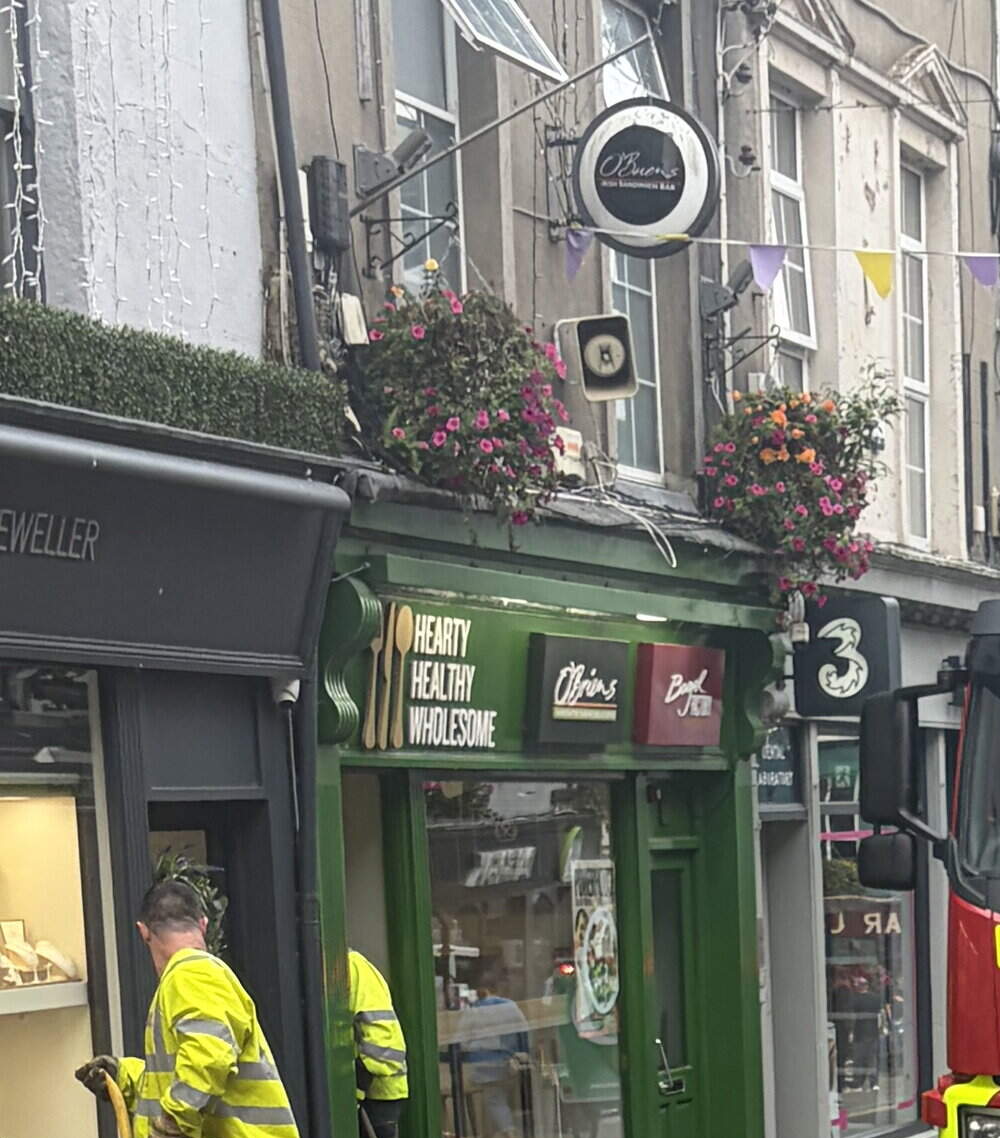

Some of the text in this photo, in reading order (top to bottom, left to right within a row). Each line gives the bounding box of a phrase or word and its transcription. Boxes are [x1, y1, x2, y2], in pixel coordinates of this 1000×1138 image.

[414, 614, 472, 658] HEARTY
[817, 617, 869, 698] 3
[411, 660, 476, 703] HEALTHY
[409, 706, 498, 748] WHOLESOME
